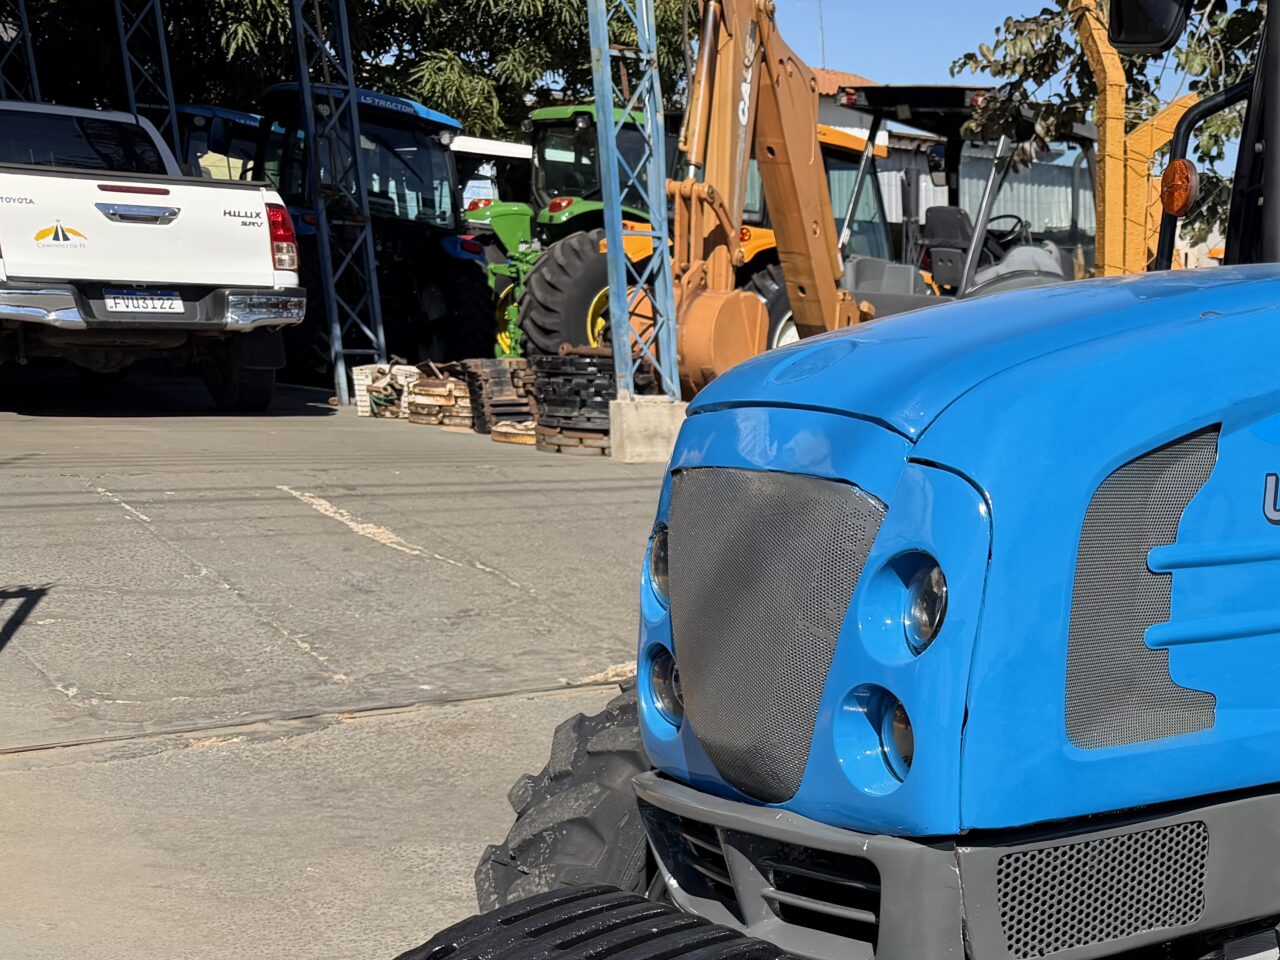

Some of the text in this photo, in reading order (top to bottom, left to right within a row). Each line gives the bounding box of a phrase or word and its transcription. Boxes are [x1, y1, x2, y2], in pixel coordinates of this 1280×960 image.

[374, 98, 416, 115] TRACTOR
[0, 196, 35, 205] TOYOTA
[223, 209, 262, 219] HILUX
